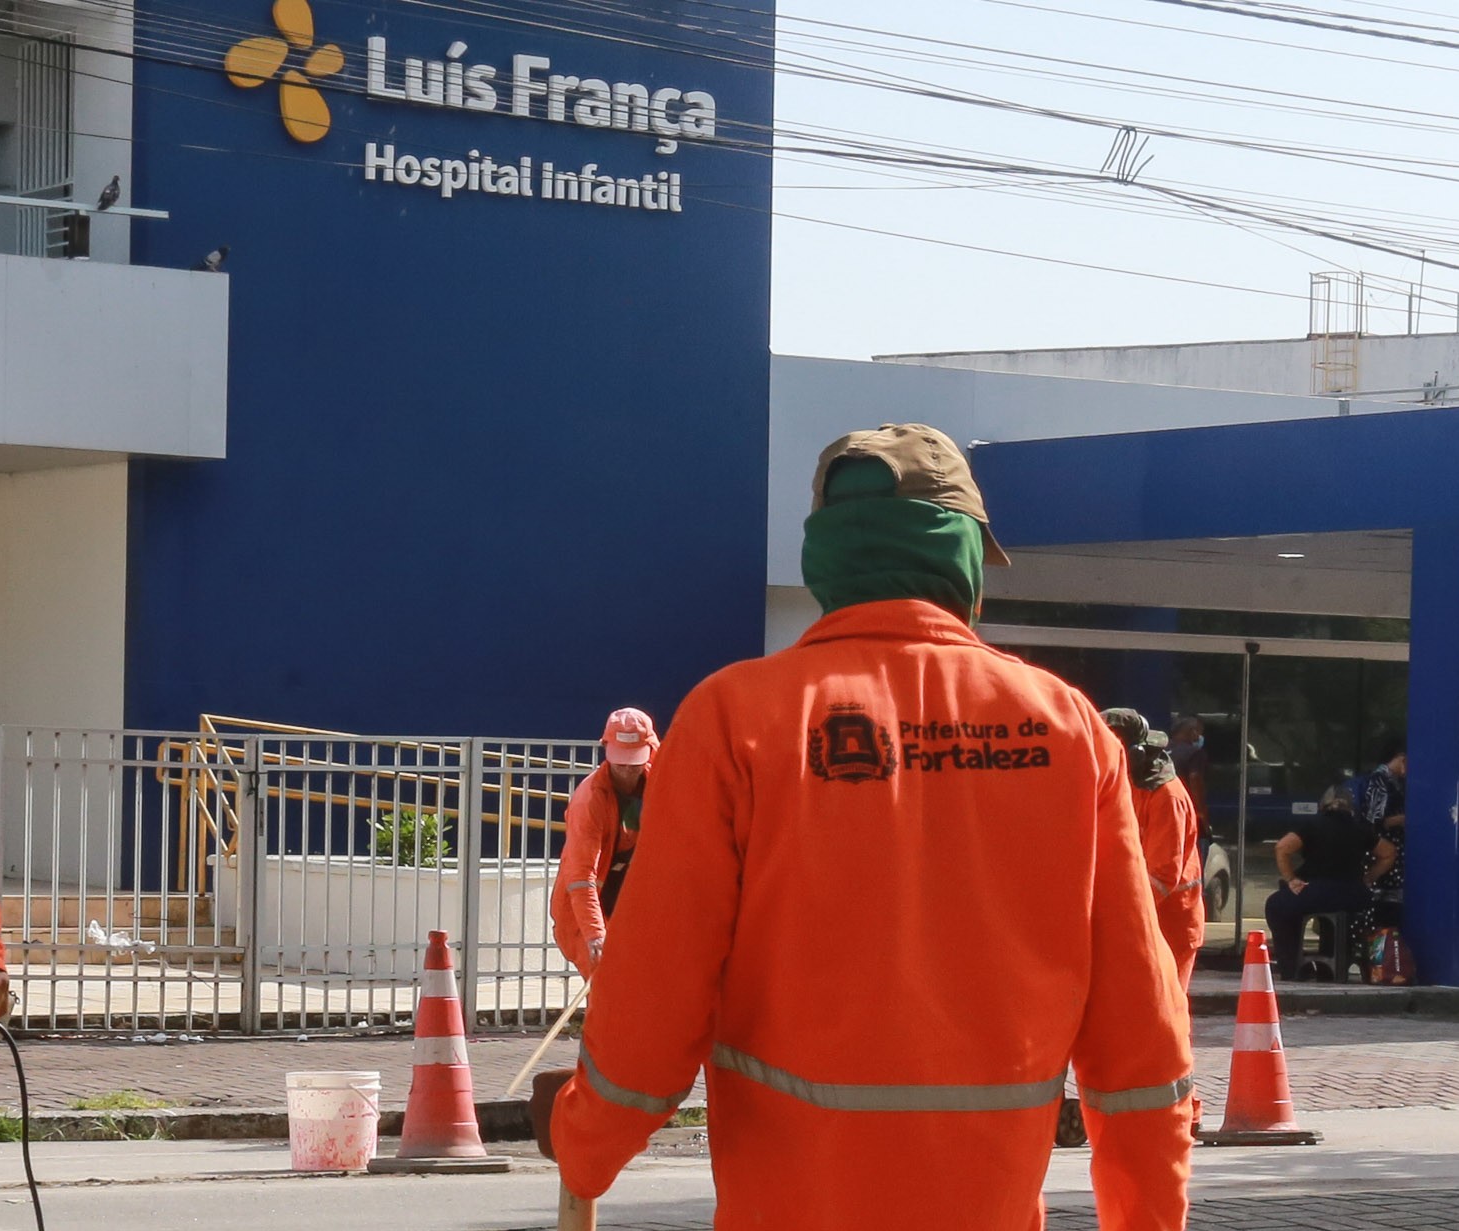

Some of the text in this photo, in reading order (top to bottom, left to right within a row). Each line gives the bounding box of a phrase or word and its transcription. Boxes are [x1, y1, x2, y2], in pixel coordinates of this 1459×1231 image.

[367, 36, 717, 154] Luís França
[365, 142, 683, 212] Hospital Infantil
[1018, 717, 1049, 737] de
[903, 742, 1051, 772] Fortaleza
